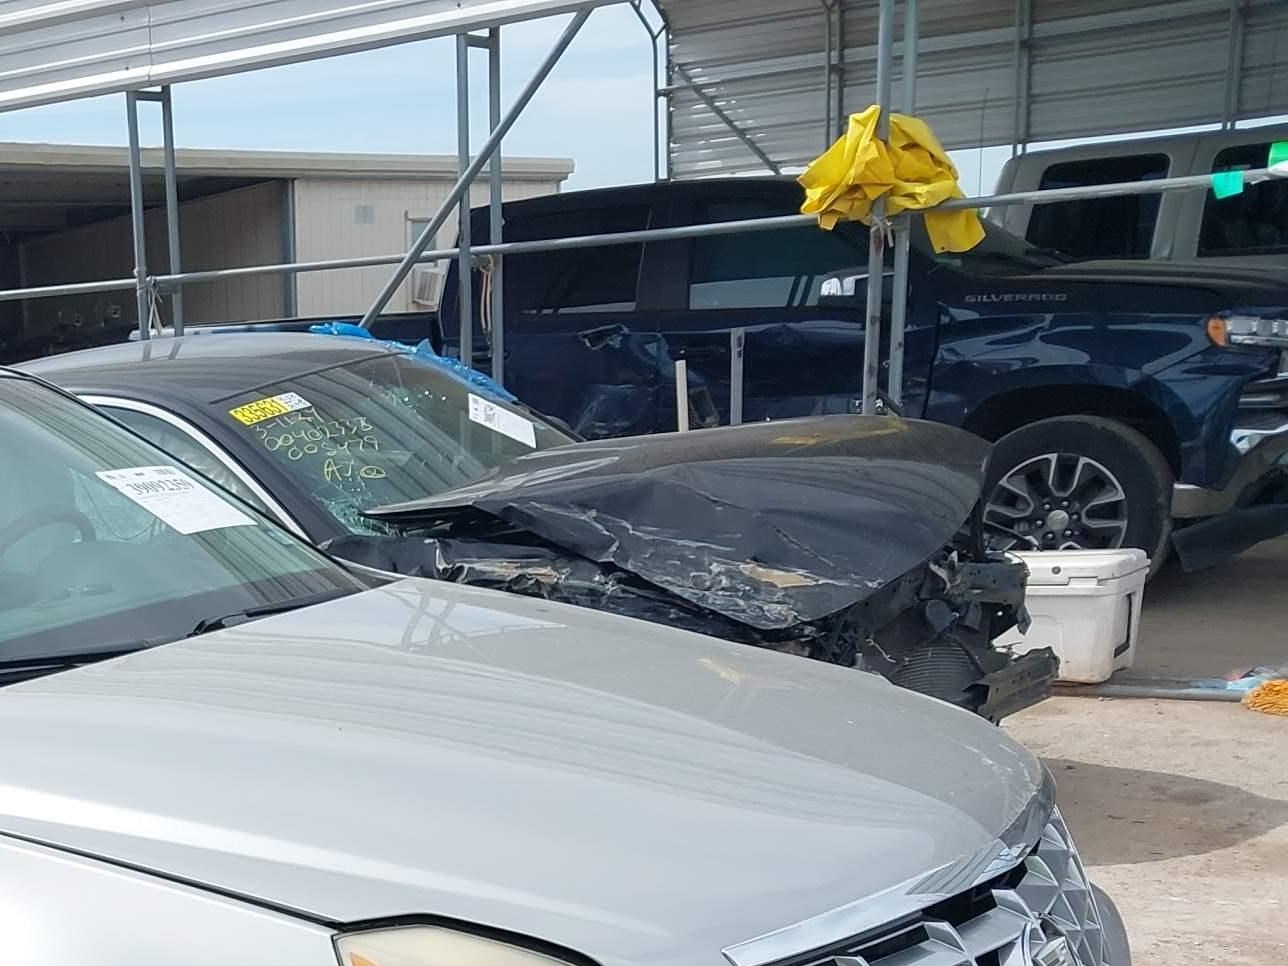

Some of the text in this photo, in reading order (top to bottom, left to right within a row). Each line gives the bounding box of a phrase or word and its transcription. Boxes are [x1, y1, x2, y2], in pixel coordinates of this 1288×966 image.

[965, 292, 1068, 303] SILVERADO
[233, 398, 289, 424] 335631
[125, 478, 196, 496] 39092359
